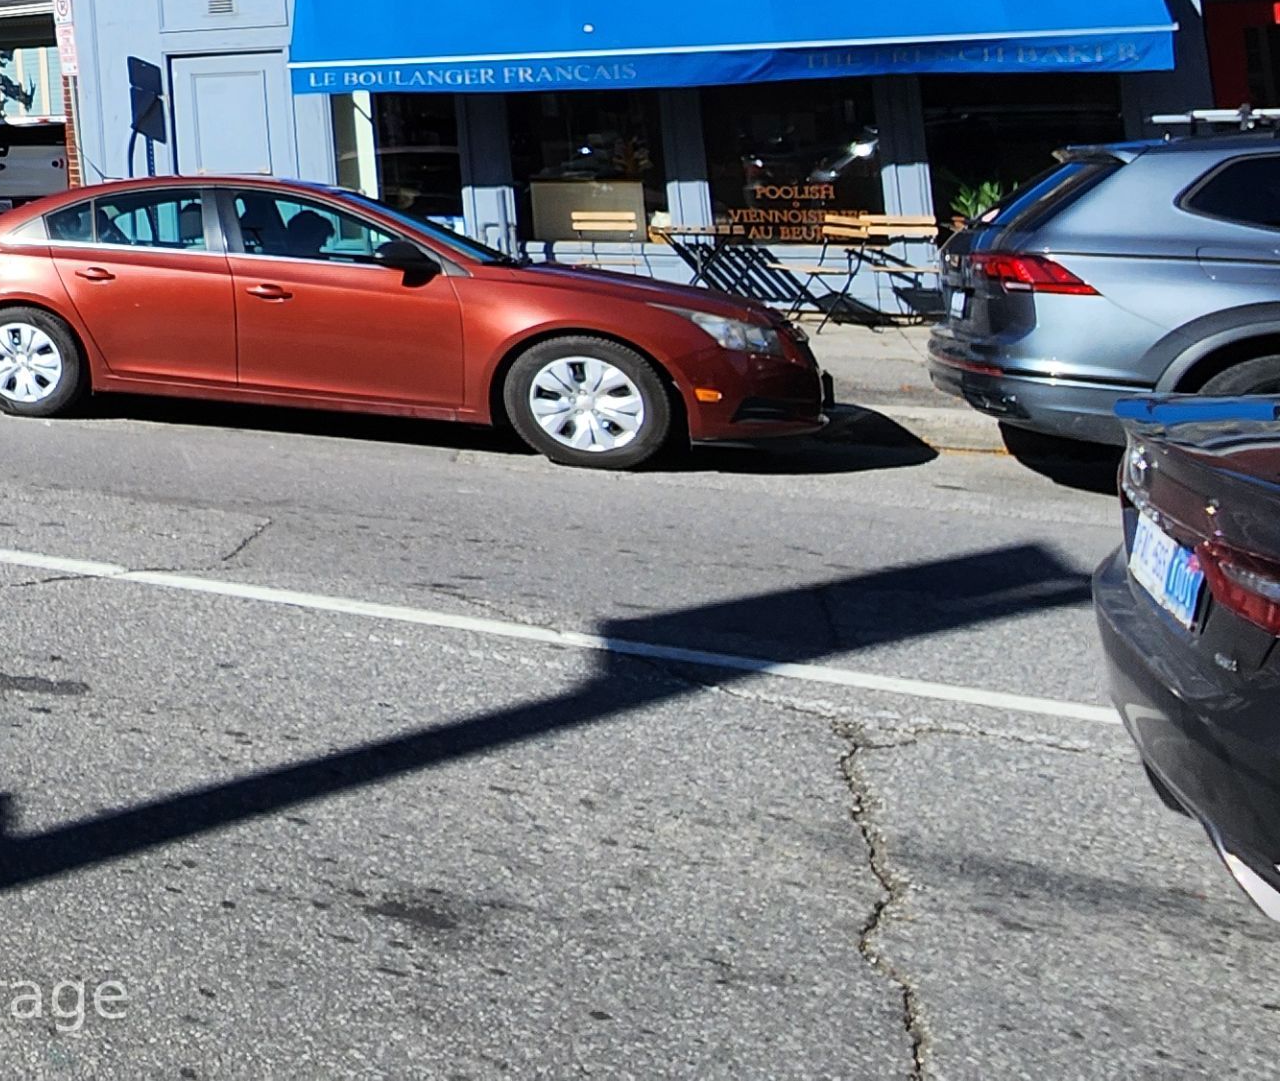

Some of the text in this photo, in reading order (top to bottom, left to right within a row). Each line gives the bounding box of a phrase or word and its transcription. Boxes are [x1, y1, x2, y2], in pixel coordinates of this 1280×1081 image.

[309, 71, 336, 88] LE
[344, 68, 495, 87] BOULANGER
[754, 184, 836, 200] POOLISH
[748, 225, 773, 240] AU
